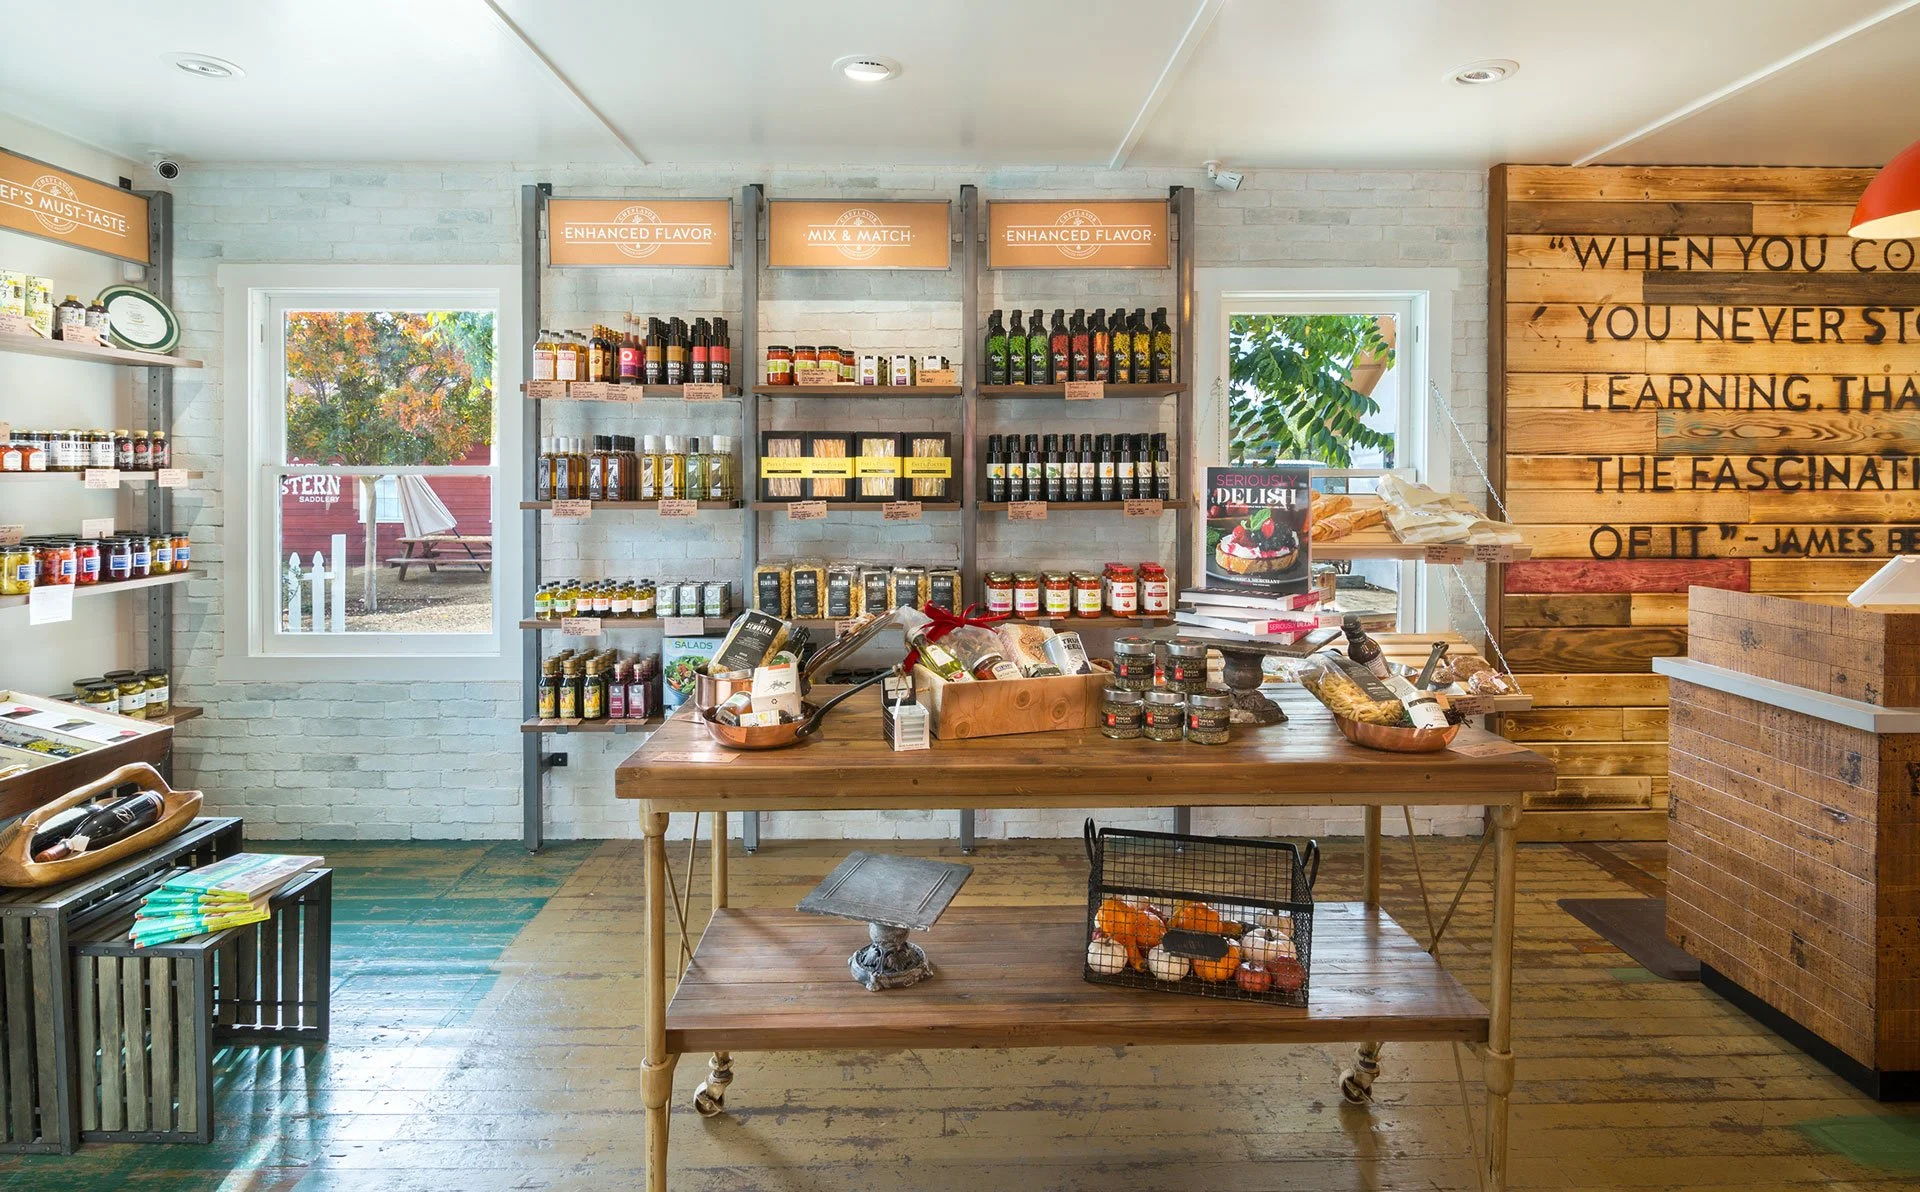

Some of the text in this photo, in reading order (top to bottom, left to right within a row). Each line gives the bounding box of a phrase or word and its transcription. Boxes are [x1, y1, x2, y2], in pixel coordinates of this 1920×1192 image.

[0, 183, 34, 206] EF’S
[39, 196, 126, 233] MUST-TASTE
[617, 207, 657, 222] CHEFLAVOR
[1059, 209, 1097, 223] CHEFLAVOR
[565, 227, 712, 240] ENHANCED FLAVOR
[808, 229, 911, 242] MIX & MATCH
[1006, 228, 1152, 242] ENHANCED FLAVOR
[1550, 235, 1916, 272] “WHEN YOU CO
[1577, 305, 1920, 345] YOU NEVER ST
[1582, 375, 1920, 415] LEARNING. THA
[1216, 474, 1298, 487] SERIOUSLY
[1587, 455, 1920, 493] THE FASCINATI
[281, 474, 341, 496] STERN
[1215, 487, 1297, 507] DELISH
[1589, 525, 1652, 560] OF
[745, 622, 773, 636] SEMOLINA
[674, 641, 713, 650] SALADS
